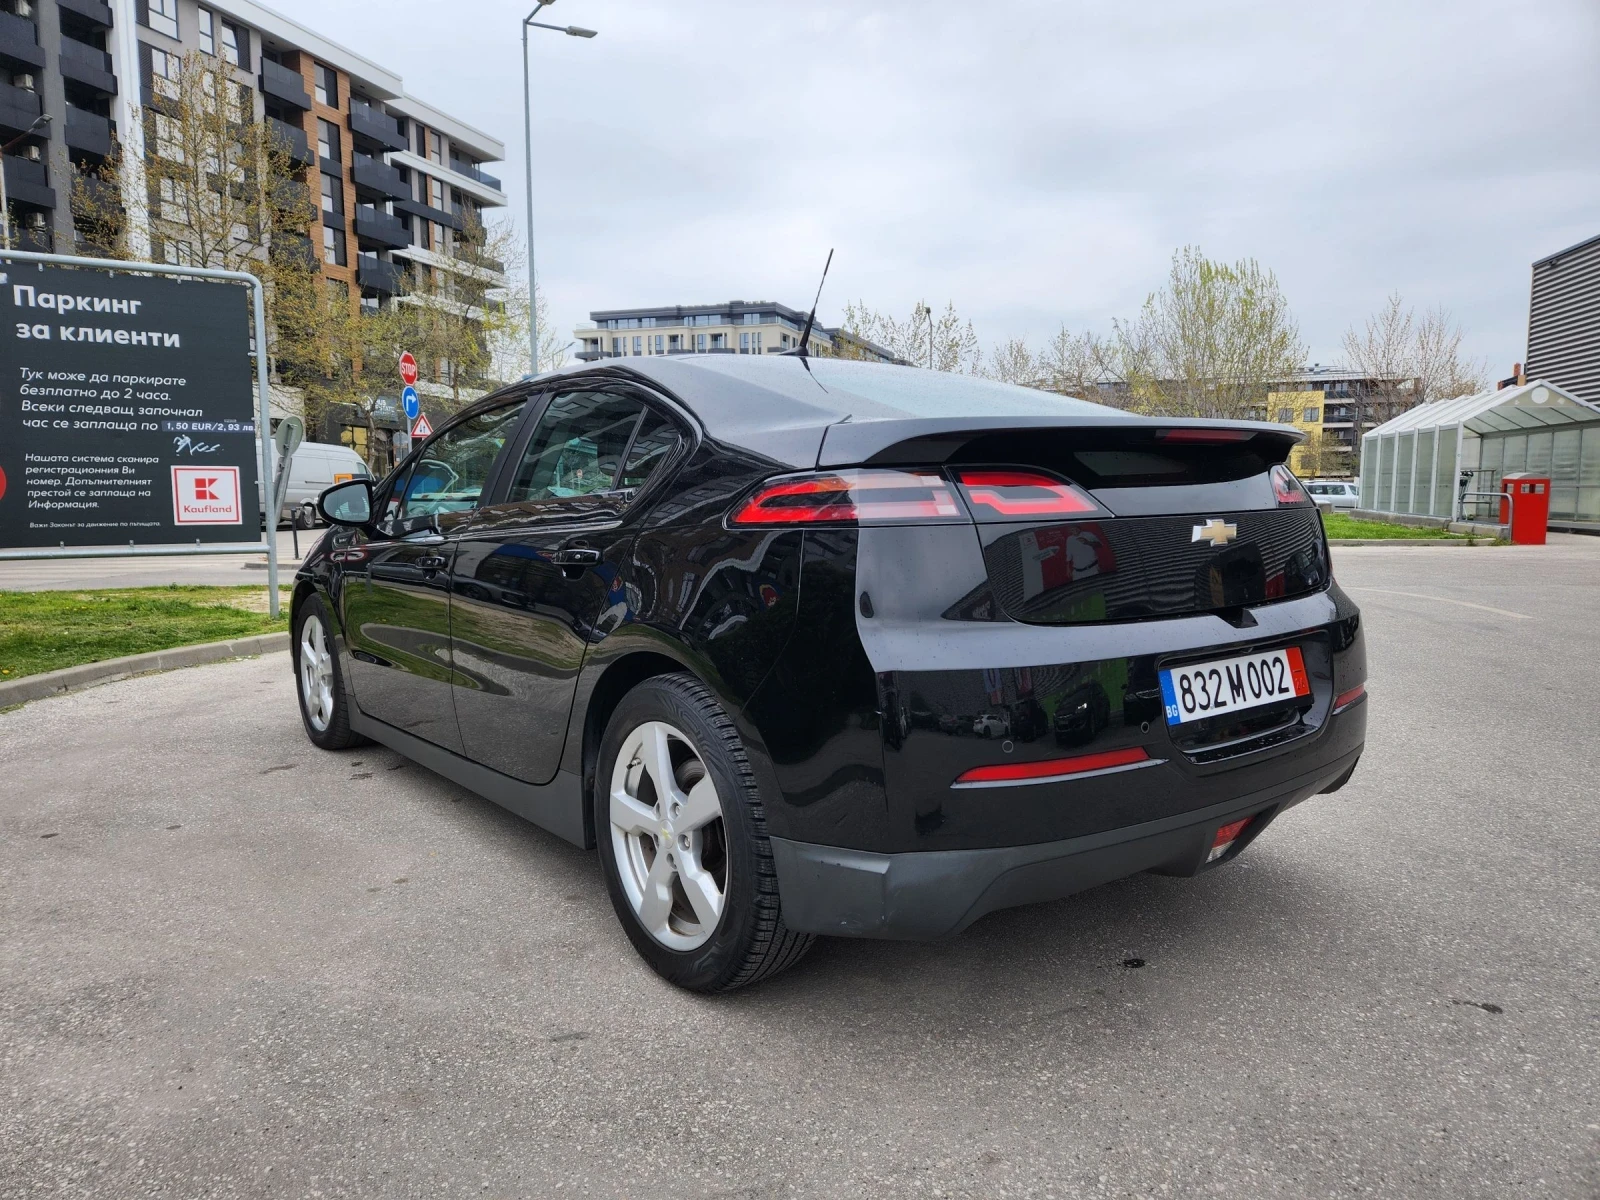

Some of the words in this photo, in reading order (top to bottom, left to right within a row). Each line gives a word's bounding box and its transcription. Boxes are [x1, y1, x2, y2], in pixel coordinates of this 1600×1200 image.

[13, 284, 142, 315] Паркинг
[15, 322, 50, 340] за
[59, 325, 181, 348] клиенти
[401, 362, 415, 376] STOP
[20, 367, 44, 381] Тук
[47, 371, 86, 381] може
[89, 374, 109, 384] да
[112, 374, 187, 386] паркирате
[20, 384, 97, 397] безплатно
[100, 390, 120, 400] до
[123, 388, 133, 399] 2
[136, 391, 172, 401] часа.
[21, 400, 65, 412] Всеки
[68, 404, 134, 416] следващ
[138, 407, 203, 417] започнал
[22, 419, 49, 428] час
[52, 420, 69, 428] се
[73, 420, 137, 431] заплаща
[141, 422, 158, 431] по
[24, 453, 69, 463] Нашата
[71, 455, 114, 463] система
[116, 455, 160, 465] сканира
[25, 466, 120, 475] регистрационния
[121, 466, 136, 474] Ви
[26, 478, 63, 486] номер.
[64, 477, 153, 487] Допълнителният
[27, 489, 72, 498] престой
[88, 490, 136, 498] заплаща
[28, 500, 100, 510] Информация.
[183, 504, 232, 513] Kaufland
[1179, 656, 1290, 714] 832M002
[1165, 704, 1178, 718] BG
